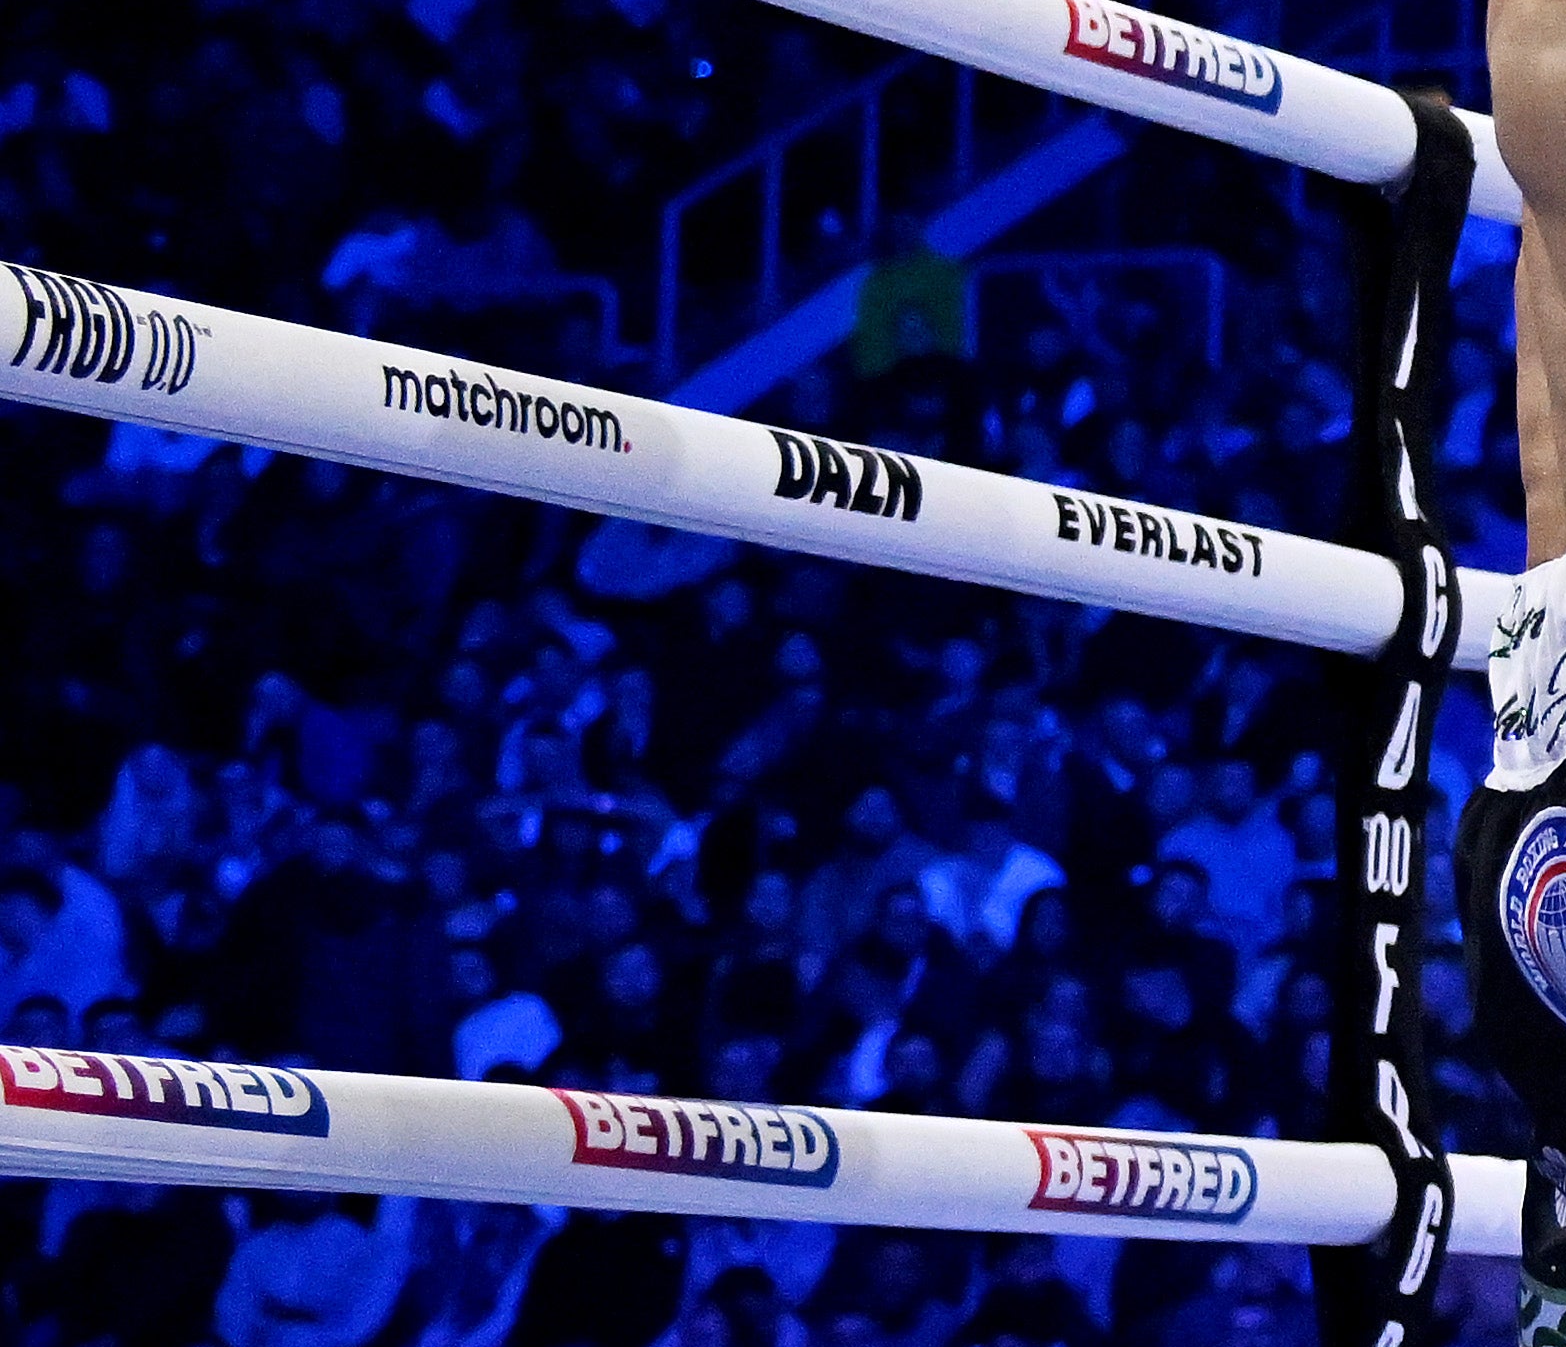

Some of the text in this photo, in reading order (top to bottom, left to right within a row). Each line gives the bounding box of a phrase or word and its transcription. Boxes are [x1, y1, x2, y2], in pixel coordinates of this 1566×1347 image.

[382, 358, 634, 455] matchroom.
[767, 427, 925, 522] DAZN
[1052, 492, 1264, 578] EVERLAST
[3, 1045, 314, 1119] BETFRED
[583, 1091, 831, 1171] BETFRED
[1042, 1136, 1254, 1217] BETFRED
